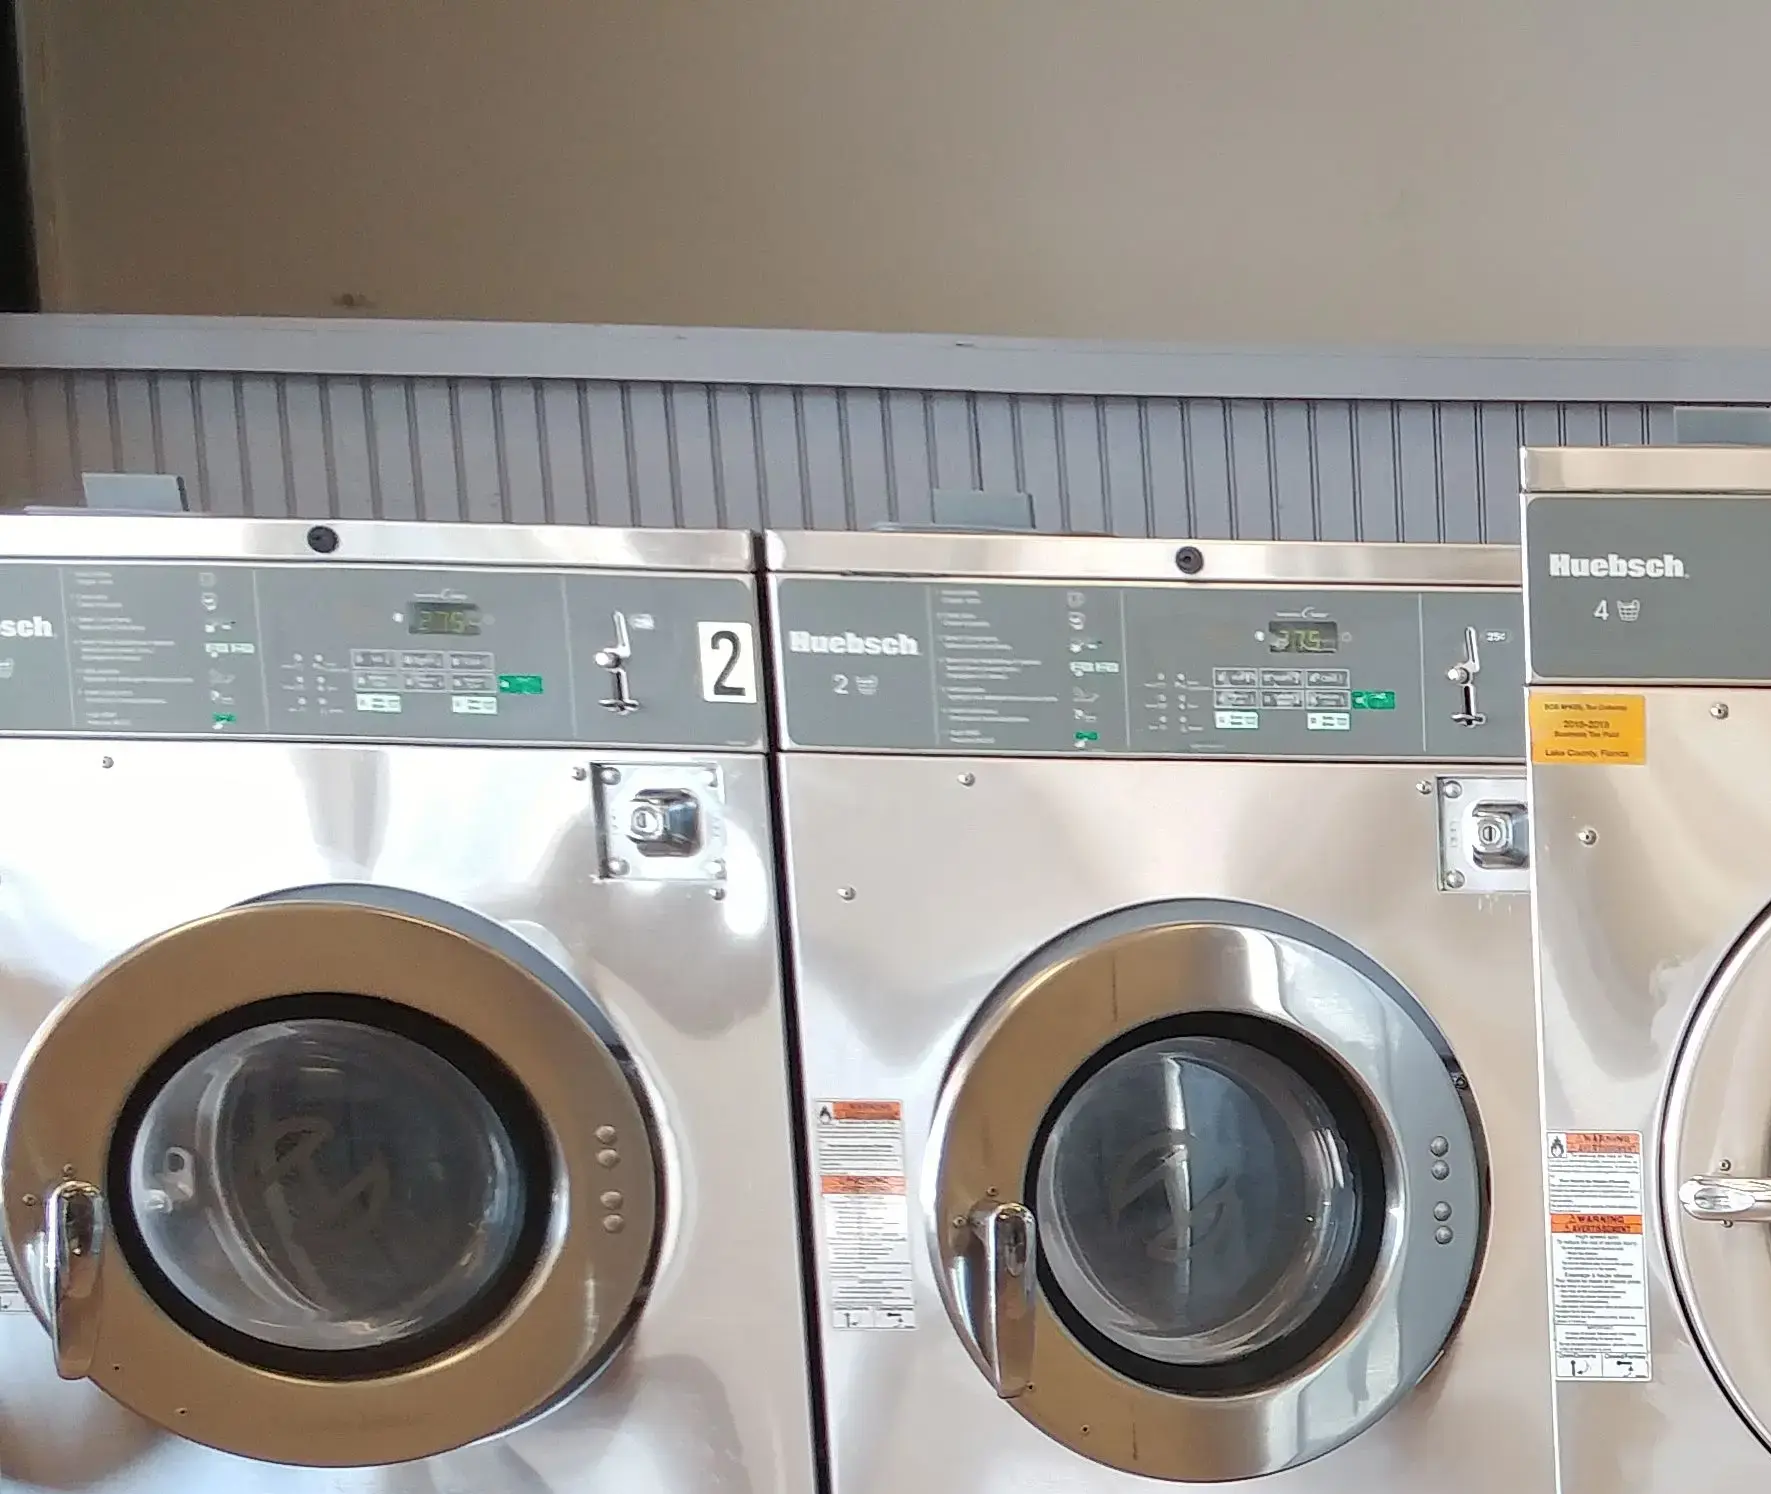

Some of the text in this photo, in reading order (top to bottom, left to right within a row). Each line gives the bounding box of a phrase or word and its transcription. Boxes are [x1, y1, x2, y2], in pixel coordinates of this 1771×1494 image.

[1549, 554, 1687, 578] Huebsch
[1594, 600, 1609, 621] 4
[789, 630, 919, 655] Huebsch
[711, 630, 747, 697] 2
[833, 673, 849, 695] 2
[1578, 1215, 1625, 1224] WARNING
